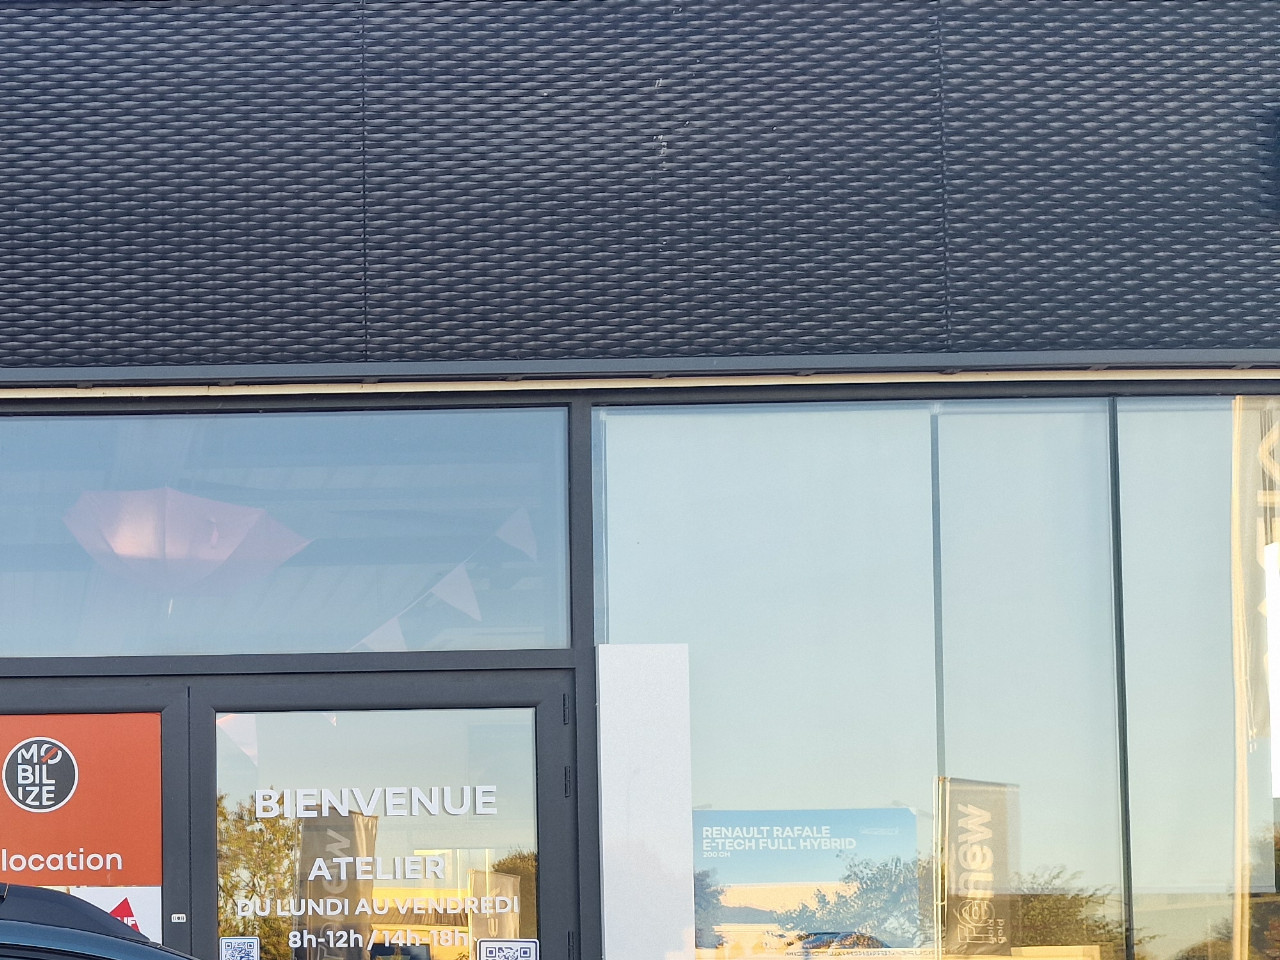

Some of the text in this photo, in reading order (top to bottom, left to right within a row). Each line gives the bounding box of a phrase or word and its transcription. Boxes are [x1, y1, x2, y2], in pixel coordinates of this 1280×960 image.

[255, 785, 498, 819] BIENVENUE
[702, 825, 831, 838] RENAULT RAFALE
[702, 837, 857, 851] E-TECH FULL HYBRID
[1, 847, 123, 872] location
[307, 856, 446, 881] ATELIER
[237, 896, 520, 917] DU LUNDI AU VENDREDI
[288, 930, 364, 949] 8h-12h
[383, 929, 468, 949] 14h-18h
